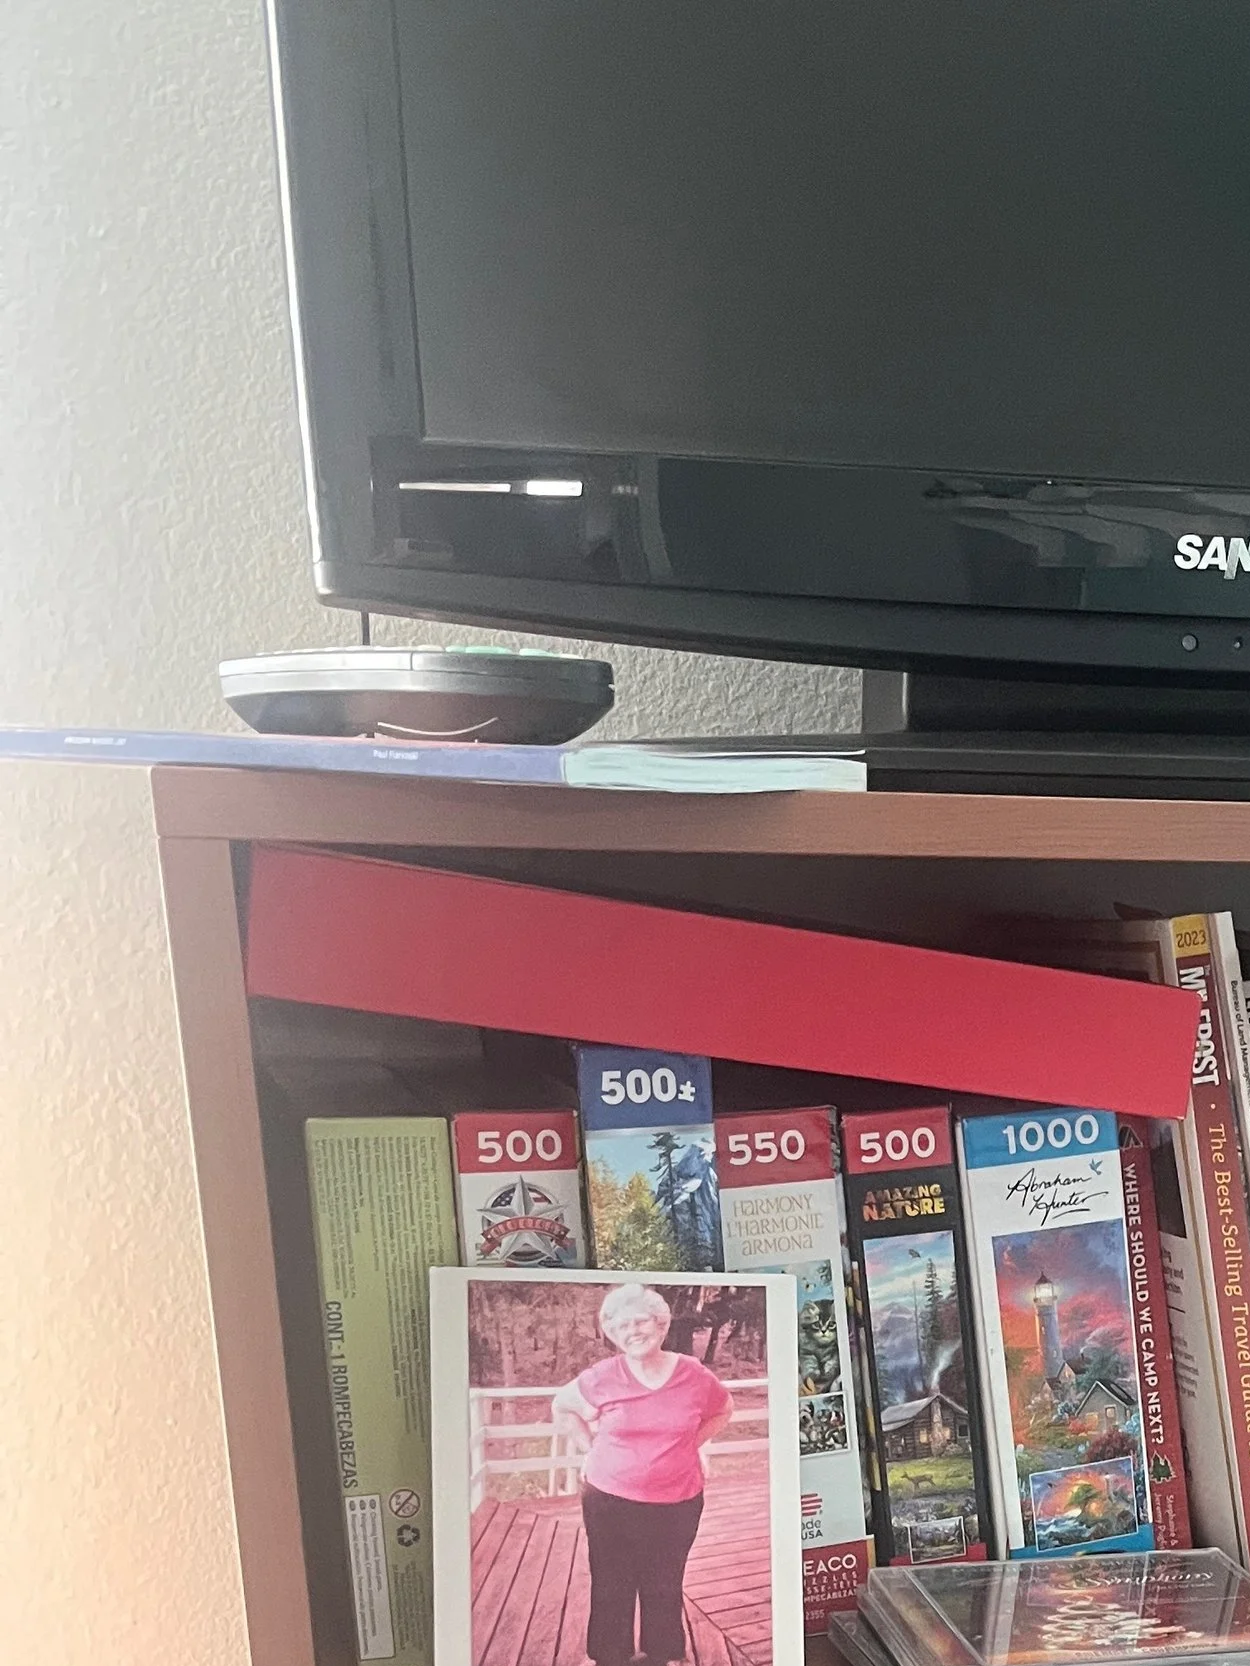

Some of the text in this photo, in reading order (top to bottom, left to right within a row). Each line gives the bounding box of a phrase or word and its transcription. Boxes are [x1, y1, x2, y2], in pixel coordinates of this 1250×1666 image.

[1176, 929, 1206, 948] 2023
[1230, 979, 1241, 1010] Bureau
[1180, 966, 1220, 1086] MPOST
[1234, 1013, 1243, 1022] of
[1236, 1024, 1247, 1045] Land
[601, 1067, 677, 1105] 500
[477, 1129, 562, 1164] 500
[728, 1129, 806, 1166] 550
[859, 1126, 937, 1164] 500
[1002, 1113, 1100, 1156] 1000
[1208, 1124, 1227, 1163] The
[863, 1183, 942, 1205] AMAZING
[1005, 1167, 1093, 1207] Abraham
[862, 1197, 945, 1222] NATURE
[1029, 1189, 1109, 1227] Hunter
[1214, 1170, 1243, 1297] Best-Selling
[1122, 1162, 1164, 1445] WHERE SHOULD WE CAMP NEXT?
[332, 1364, 358, 1489] ROMPECABEZAS
[803, 1554, 857, 1576] EACO
